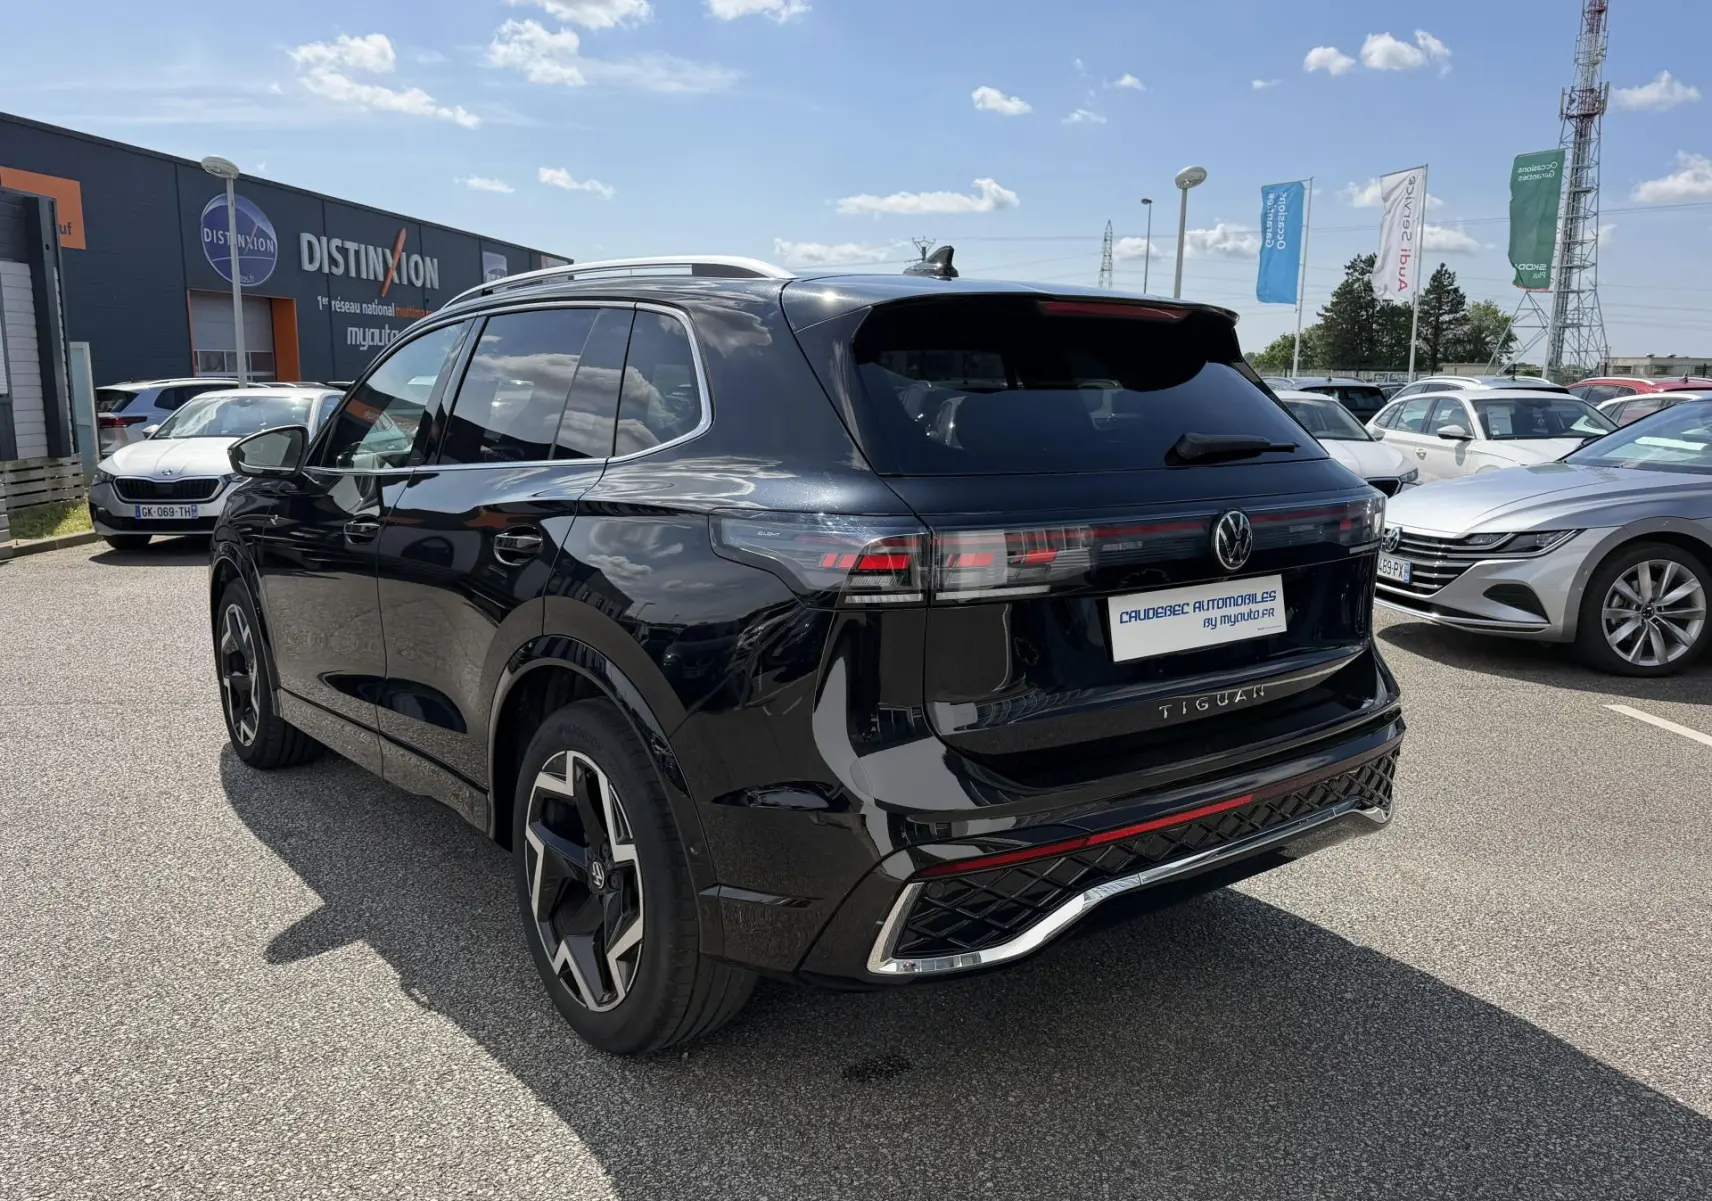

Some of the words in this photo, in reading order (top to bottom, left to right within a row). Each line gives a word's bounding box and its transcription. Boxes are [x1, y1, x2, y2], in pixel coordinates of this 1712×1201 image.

[203, 224, 274, 255] DISTNXION
[299, 228, 439, 297] DISTINXION
[331, 296, 361, 314] réseau
[362, 298, 395, 317] national
[142, 506, 191, 518] GK-069-TH
[1119, 602, 1190, 625] CAUDEBEC
[1193, 590, 1277, 614] AUTOMOBILES
[1159, 684, 1265, 719] TIGUAN
